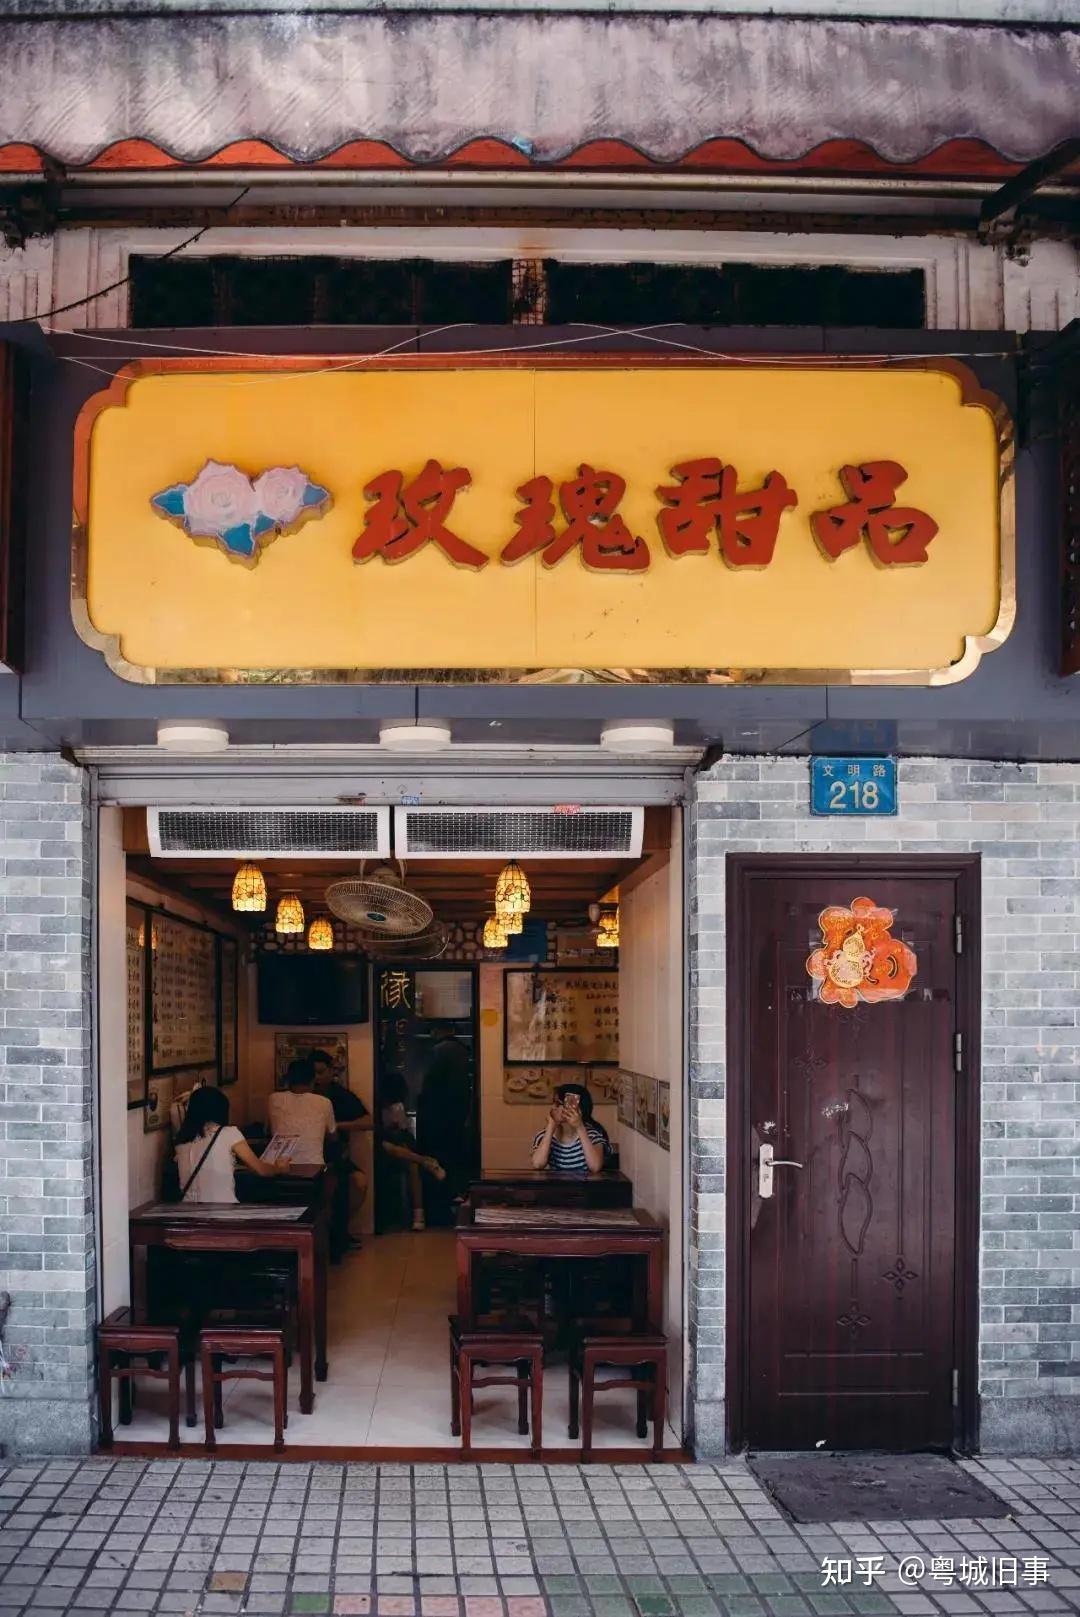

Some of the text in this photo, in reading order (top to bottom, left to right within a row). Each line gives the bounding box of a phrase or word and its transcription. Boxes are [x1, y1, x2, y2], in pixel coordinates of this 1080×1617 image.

[352, 457, 939, 573] 玫瑰甜品
[822, 763, 887, 777] 文明路
[829, 780, 879, 809] 218
